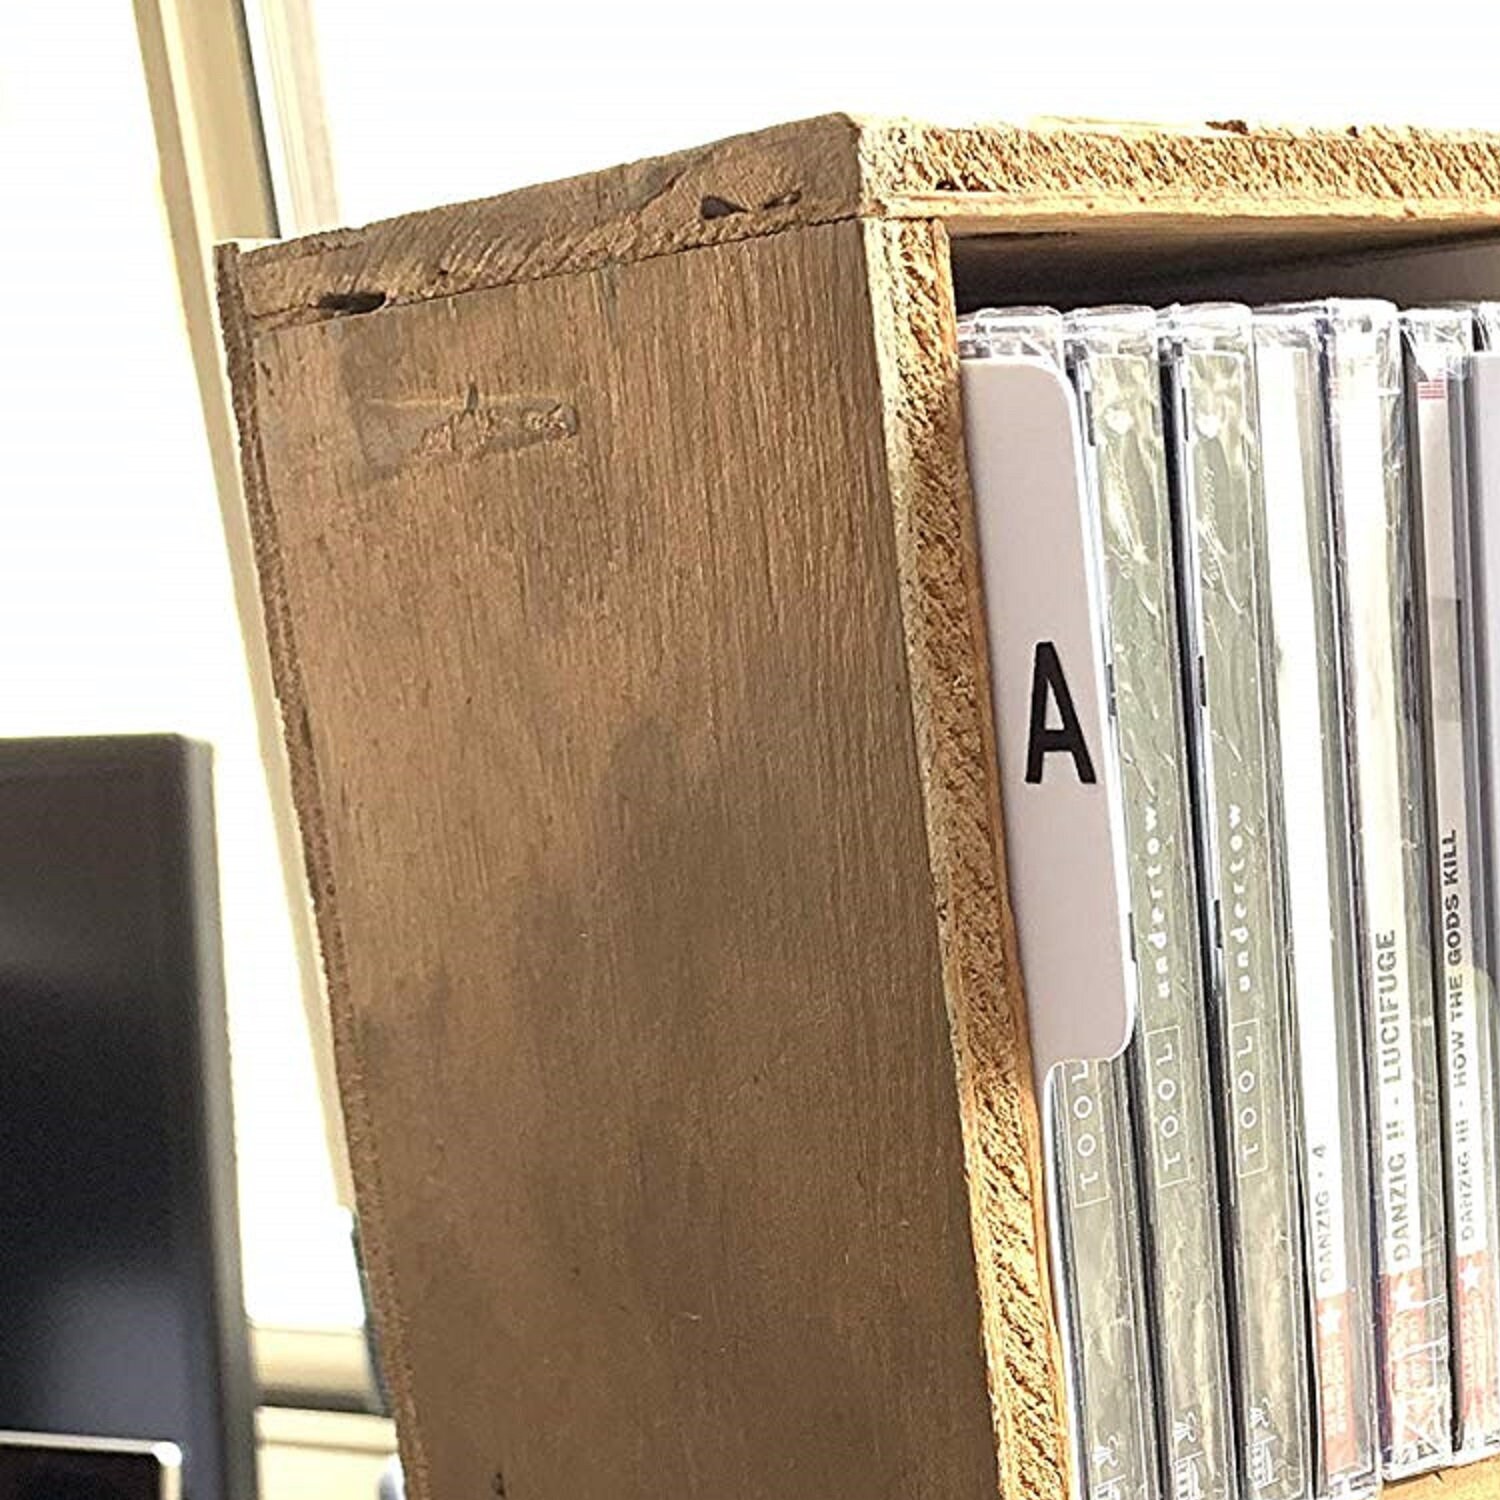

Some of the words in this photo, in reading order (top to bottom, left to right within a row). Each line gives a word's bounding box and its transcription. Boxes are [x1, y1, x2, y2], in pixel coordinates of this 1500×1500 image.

[1025, 641, 1097, 784] A
[1442, 829, 1458, 886] KILL
[1445, 896, 1462, 966] GODS
[1375, 929, 1402, 1084] LUCIFUGE
[1448, 974, 1463, 1023] THE
[1155, 1042, 1181, 1172] TOOL
[1236, 1034, 1260, 1161] TOOL
[1451, 1025, 1468, 1088] HOW
[1314, 1190, 1335, 1284] DANZIG
[1384, 1152, 1412, 1263] DANZIG
